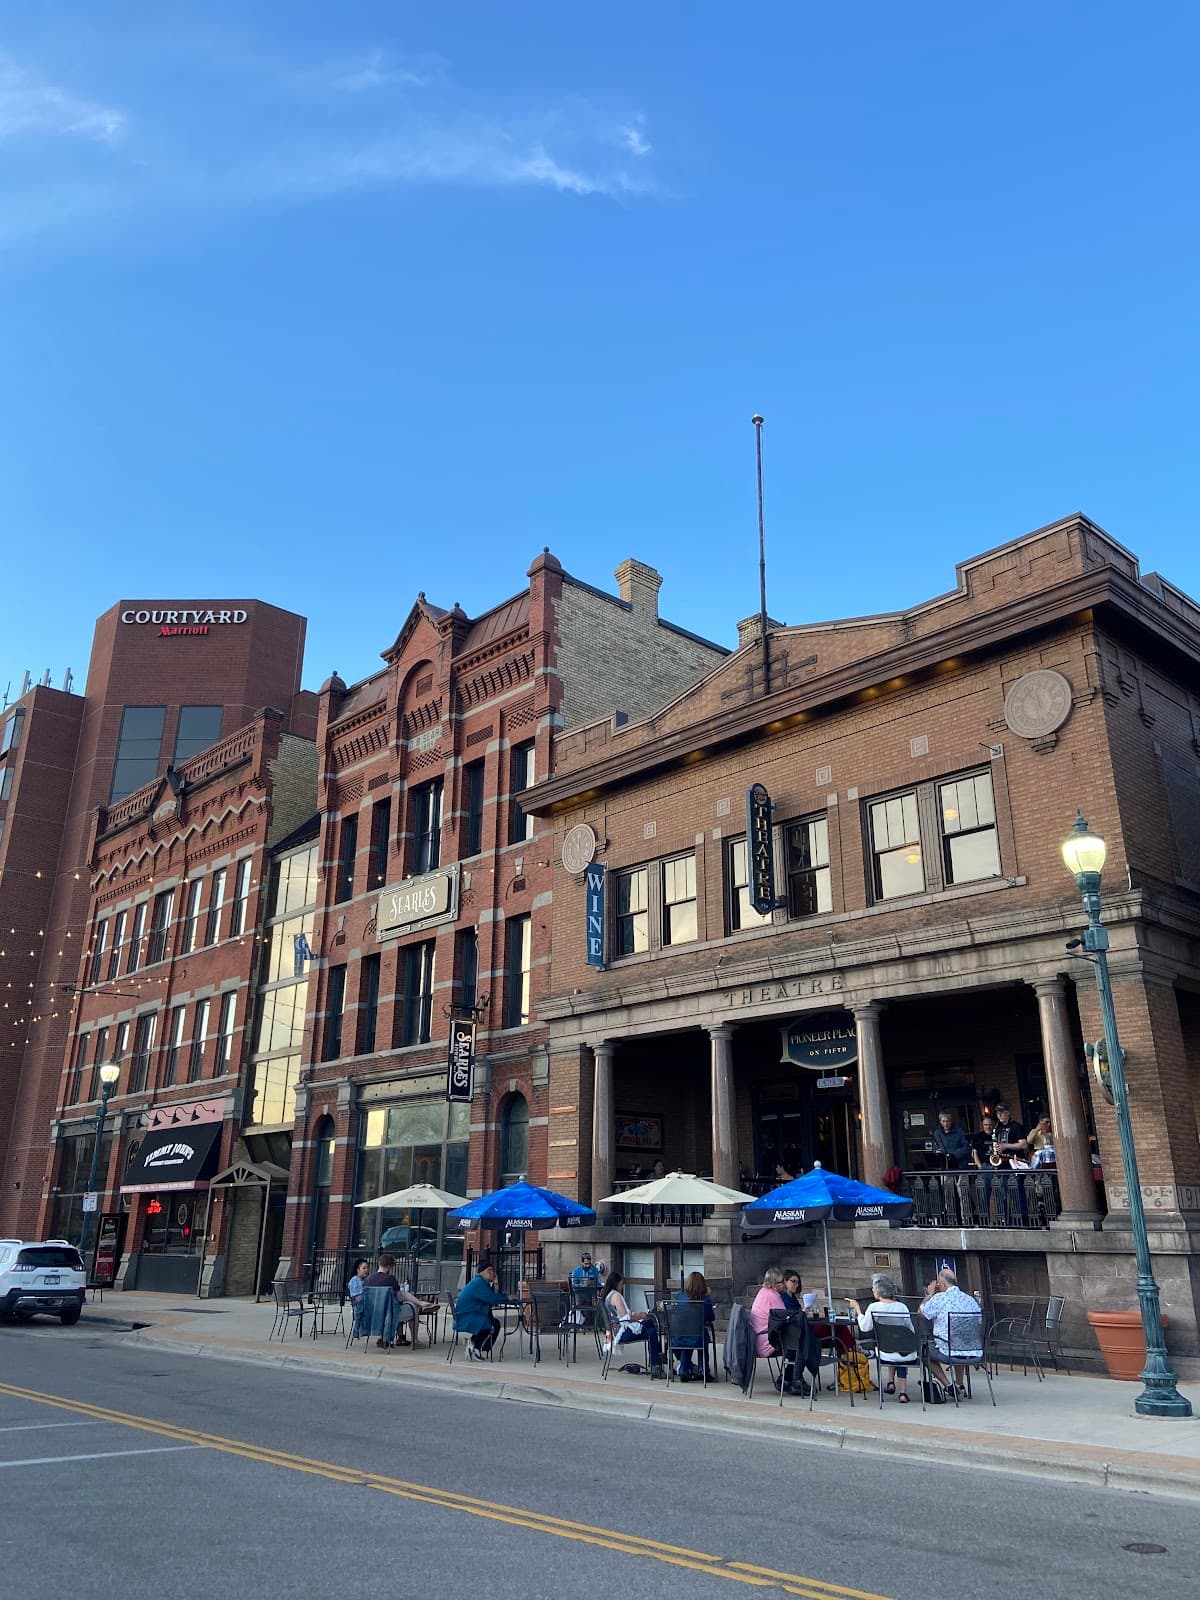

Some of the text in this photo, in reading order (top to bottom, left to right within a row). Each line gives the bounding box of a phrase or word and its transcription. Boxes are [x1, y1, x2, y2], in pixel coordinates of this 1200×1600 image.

[121, 609, 248, 625] COURTYARD
[156, 625, 208, 637] Marriott
[755, 803, 770, 900] THEATRE
[390, 886, 436, 922] SEARLES
[587, 872, 604, 956] WINE
[724, 976, 844, 1005] THEATRE
[790, 1027, 857, 1044] PIONEER PLAC
[824, 1046, 847, 1055] FIFTH
[454, 1031, 472, 1088] SEARLES
[773, 1209, 805, 1221] ALASKAN
[855, 1206, 883, 1217] ALASKAN
[505, 1218, 533, 1228] ALASKAN
